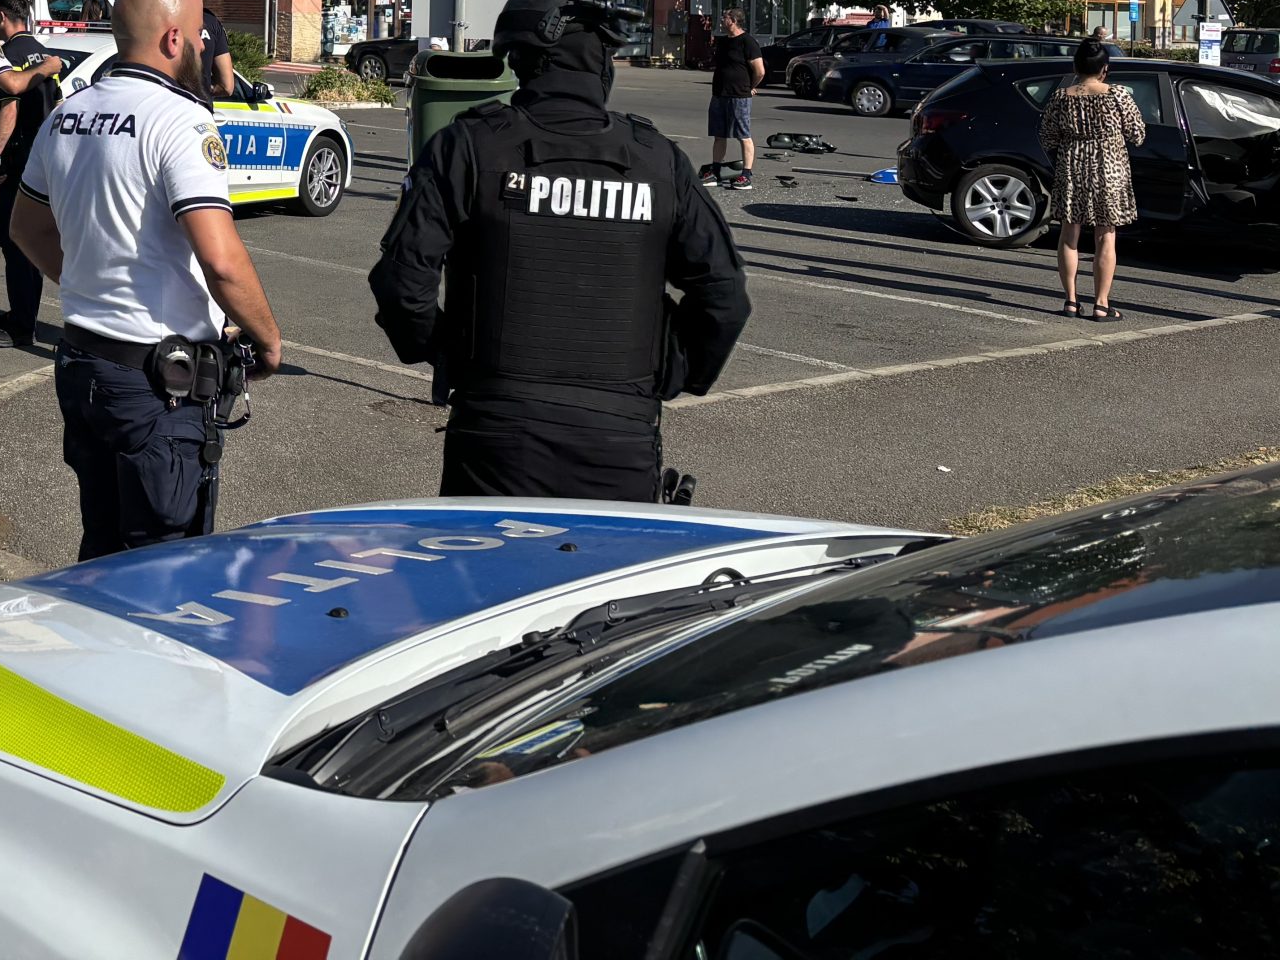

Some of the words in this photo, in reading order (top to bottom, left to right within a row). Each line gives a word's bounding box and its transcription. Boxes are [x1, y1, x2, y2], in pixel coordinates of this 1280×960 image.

[50, 111, 136, 138] POLITIA
[224, 134, 257, 156] TIA
[508, 172, 525, 190] 21
[529, 175, 652, 221] POLITIA
[127, 518, 570, 627] POLITIA
